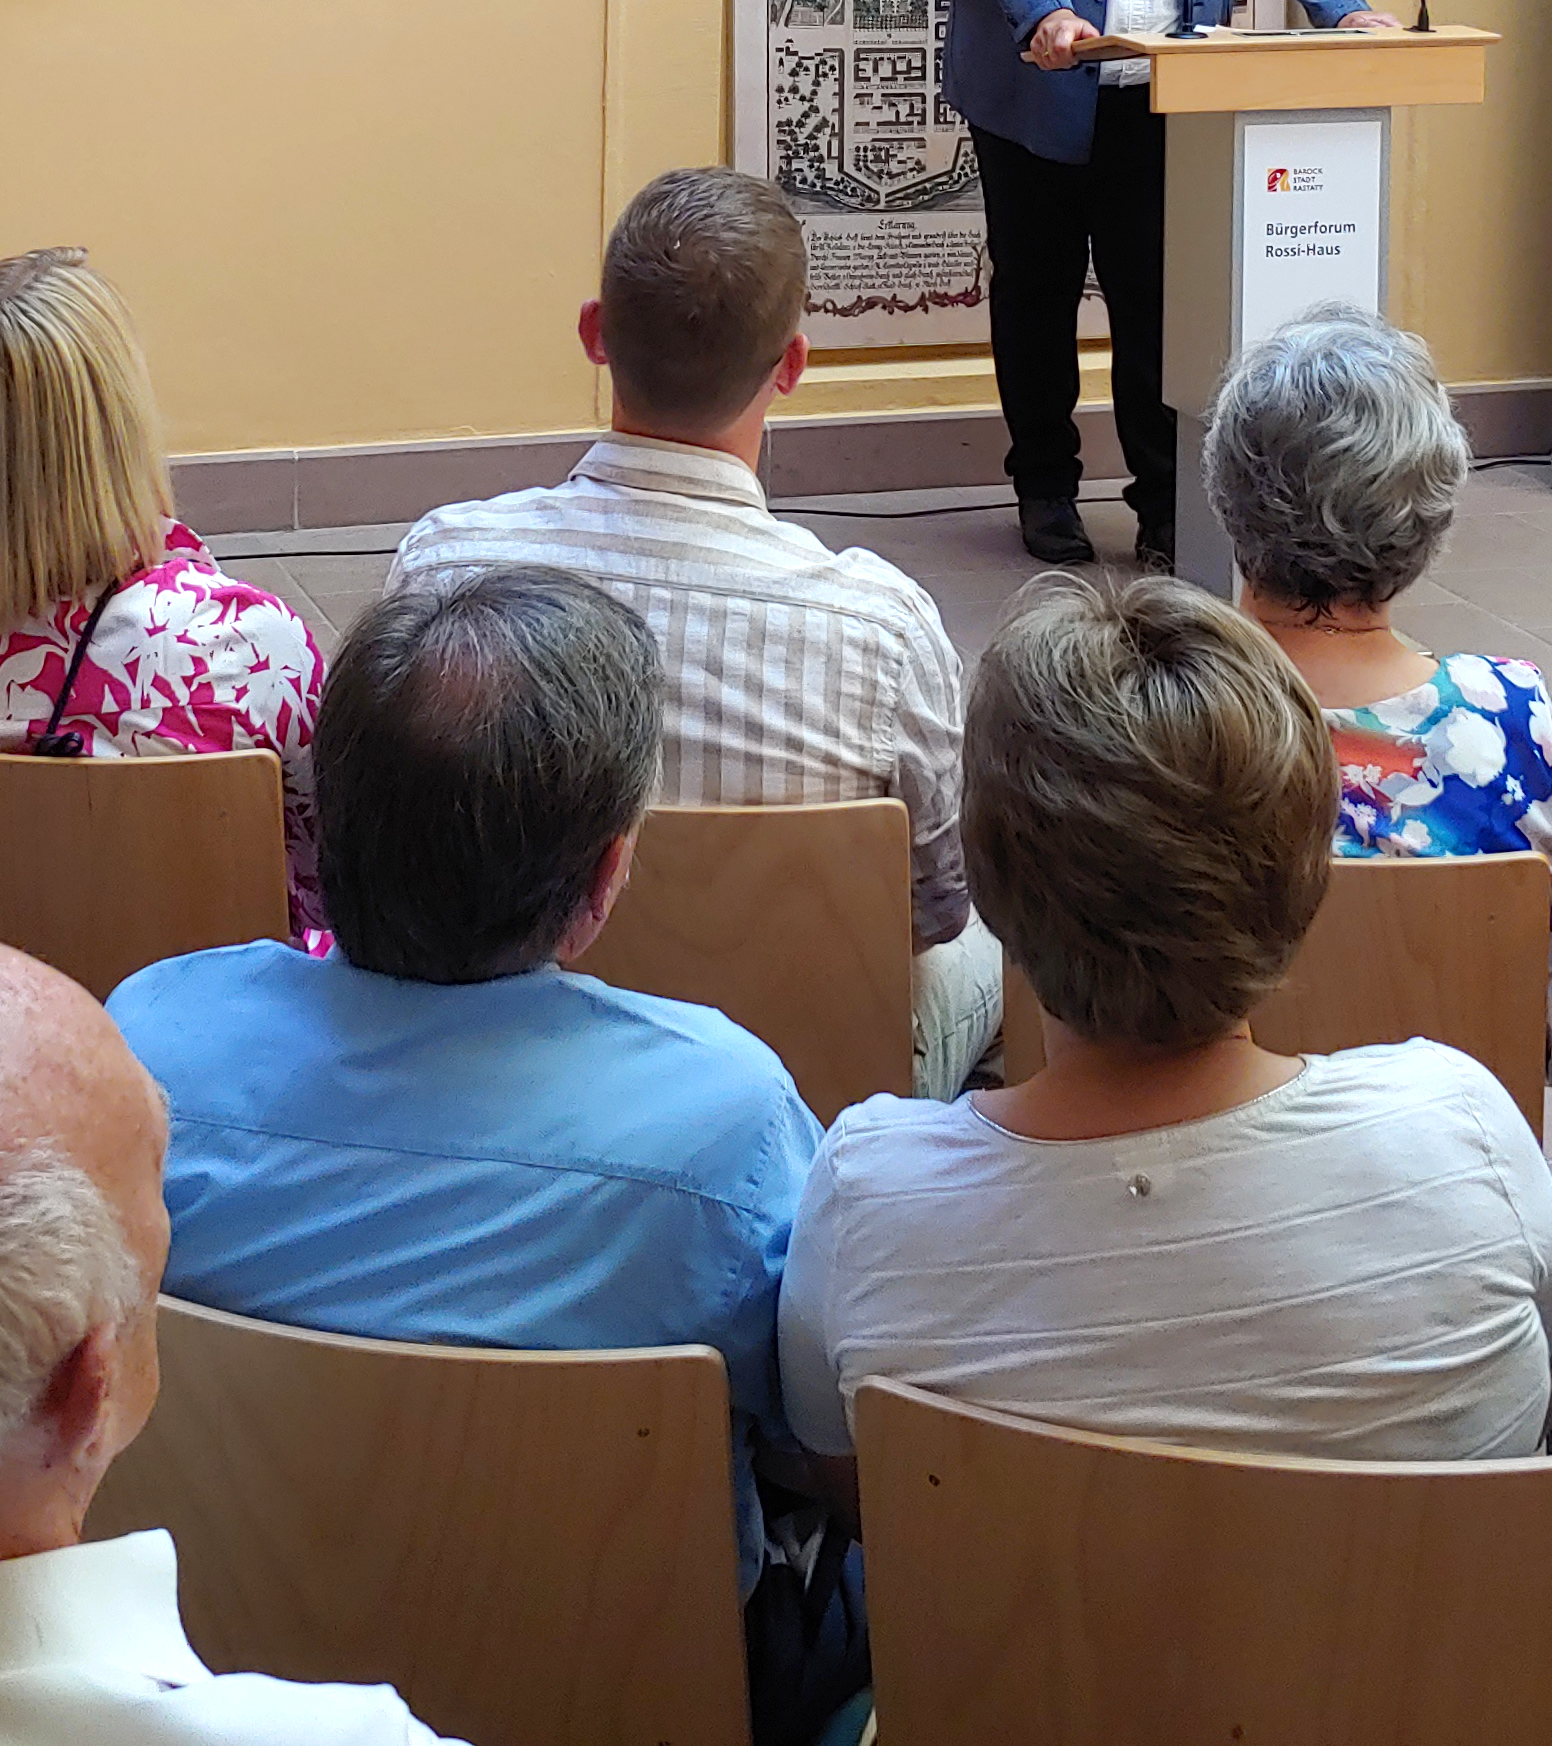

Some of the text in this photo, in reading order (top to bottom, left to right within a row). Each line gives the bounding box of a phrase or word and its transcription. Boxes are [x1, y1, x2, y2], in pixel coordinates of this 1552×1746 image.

[1293, 176, 1316, 184] STADT
[1293, 184, 1324, 192] RASTATT
[1266, 220, 1356, 239] Bürgerforum
[1265, 243, 1341, 258] Rossi-Haus
